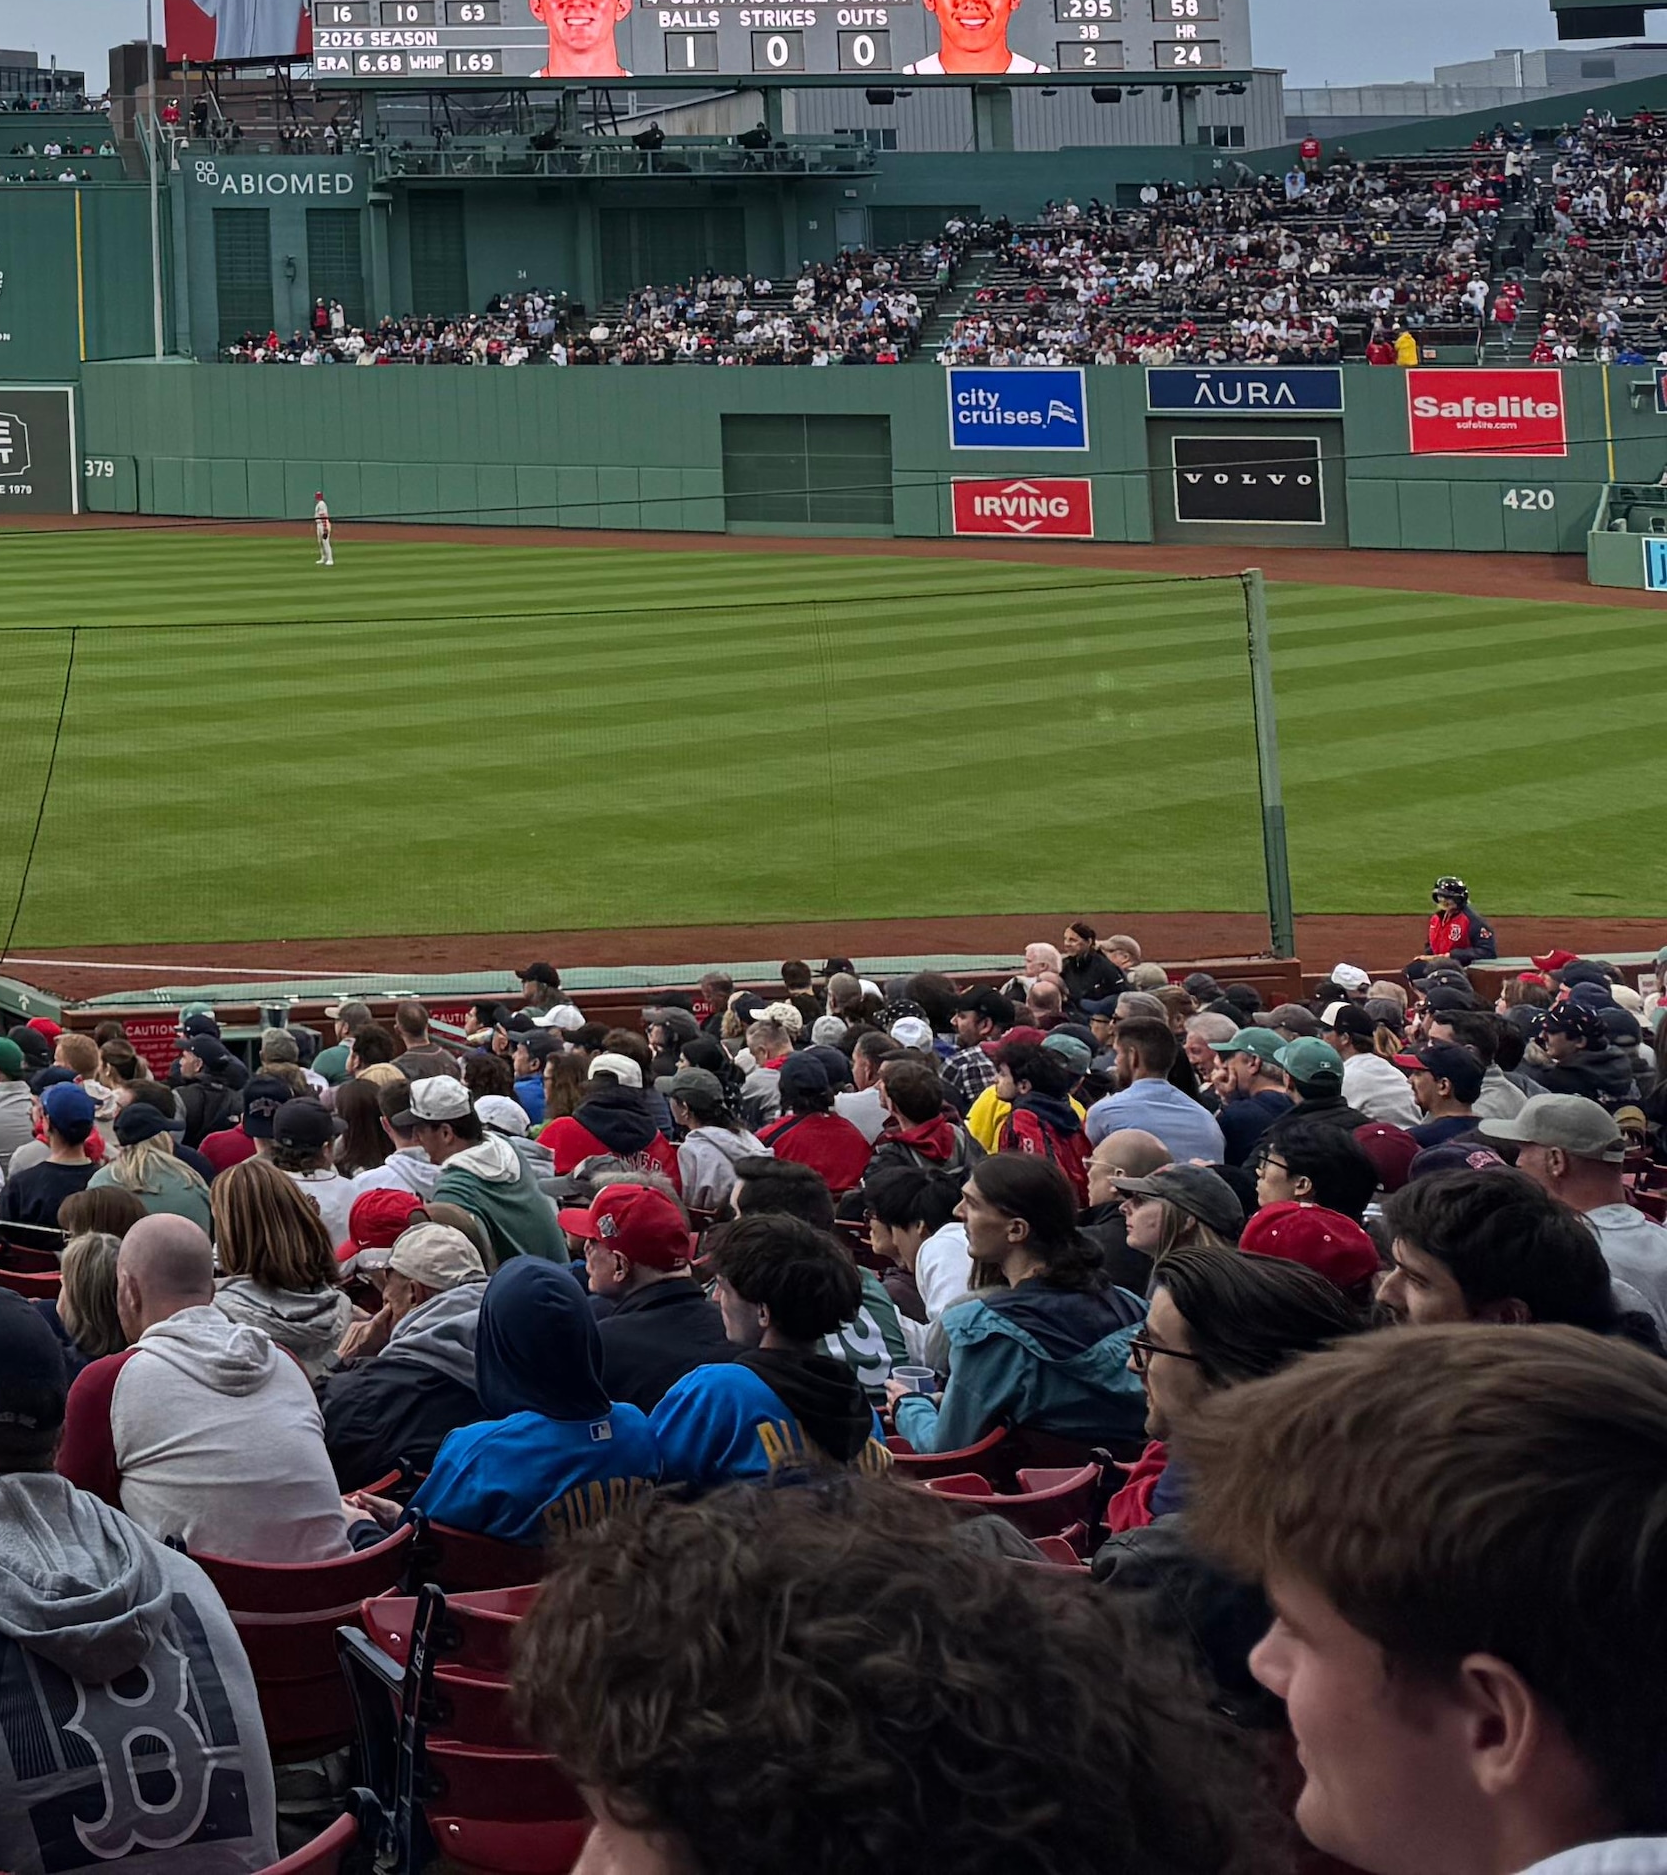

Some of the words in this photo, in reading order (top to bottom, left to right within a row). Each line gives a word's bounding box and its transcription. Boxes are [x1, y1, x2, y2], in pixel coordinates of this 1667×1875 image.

[333, 6, 352, 22] 16
[396, 5, 418, 22] 10
[460, 5, 485, 21] 63
[1062, 0, 1113, 17] .295
[658, 10, 720, 28] BALLS
[739, 9, 816, 26] STRIKES
[837, 9, 888, 25] OUTS
[320, 31, 364, 47] 2026
[370, 31, 438, 46] SEASON
[1079, 25, 1100, 39] 3B
[1175, 24, 1197, 38] HR
[685, 36, 695, 68] 1
[765, 35, 789, 67] 0
[852, 34, 875, 66] 0
[1083, 47, 1097, 66] 2
[1173, 46, 1202, 65] 24
[317, 56, 349, 71] ERA
[358, 54, 402, 72] 6.68
[410, 54, 445, 70] WHIP
[455, 54, 494, 71] 1.69
[220, 173, 355, 197] ABIOMED
[957, 388, 1000, 410] city
[958, 407, 1043, 425] cruises
[1413, 395, 1560, 422] Safelite
[84, 460, 115, 478] 379
[1183, 471, 1314, 486] VOLVO
[974, 496, 1070, 518] IRVING
[1502, 487, 1556, 512] 420
